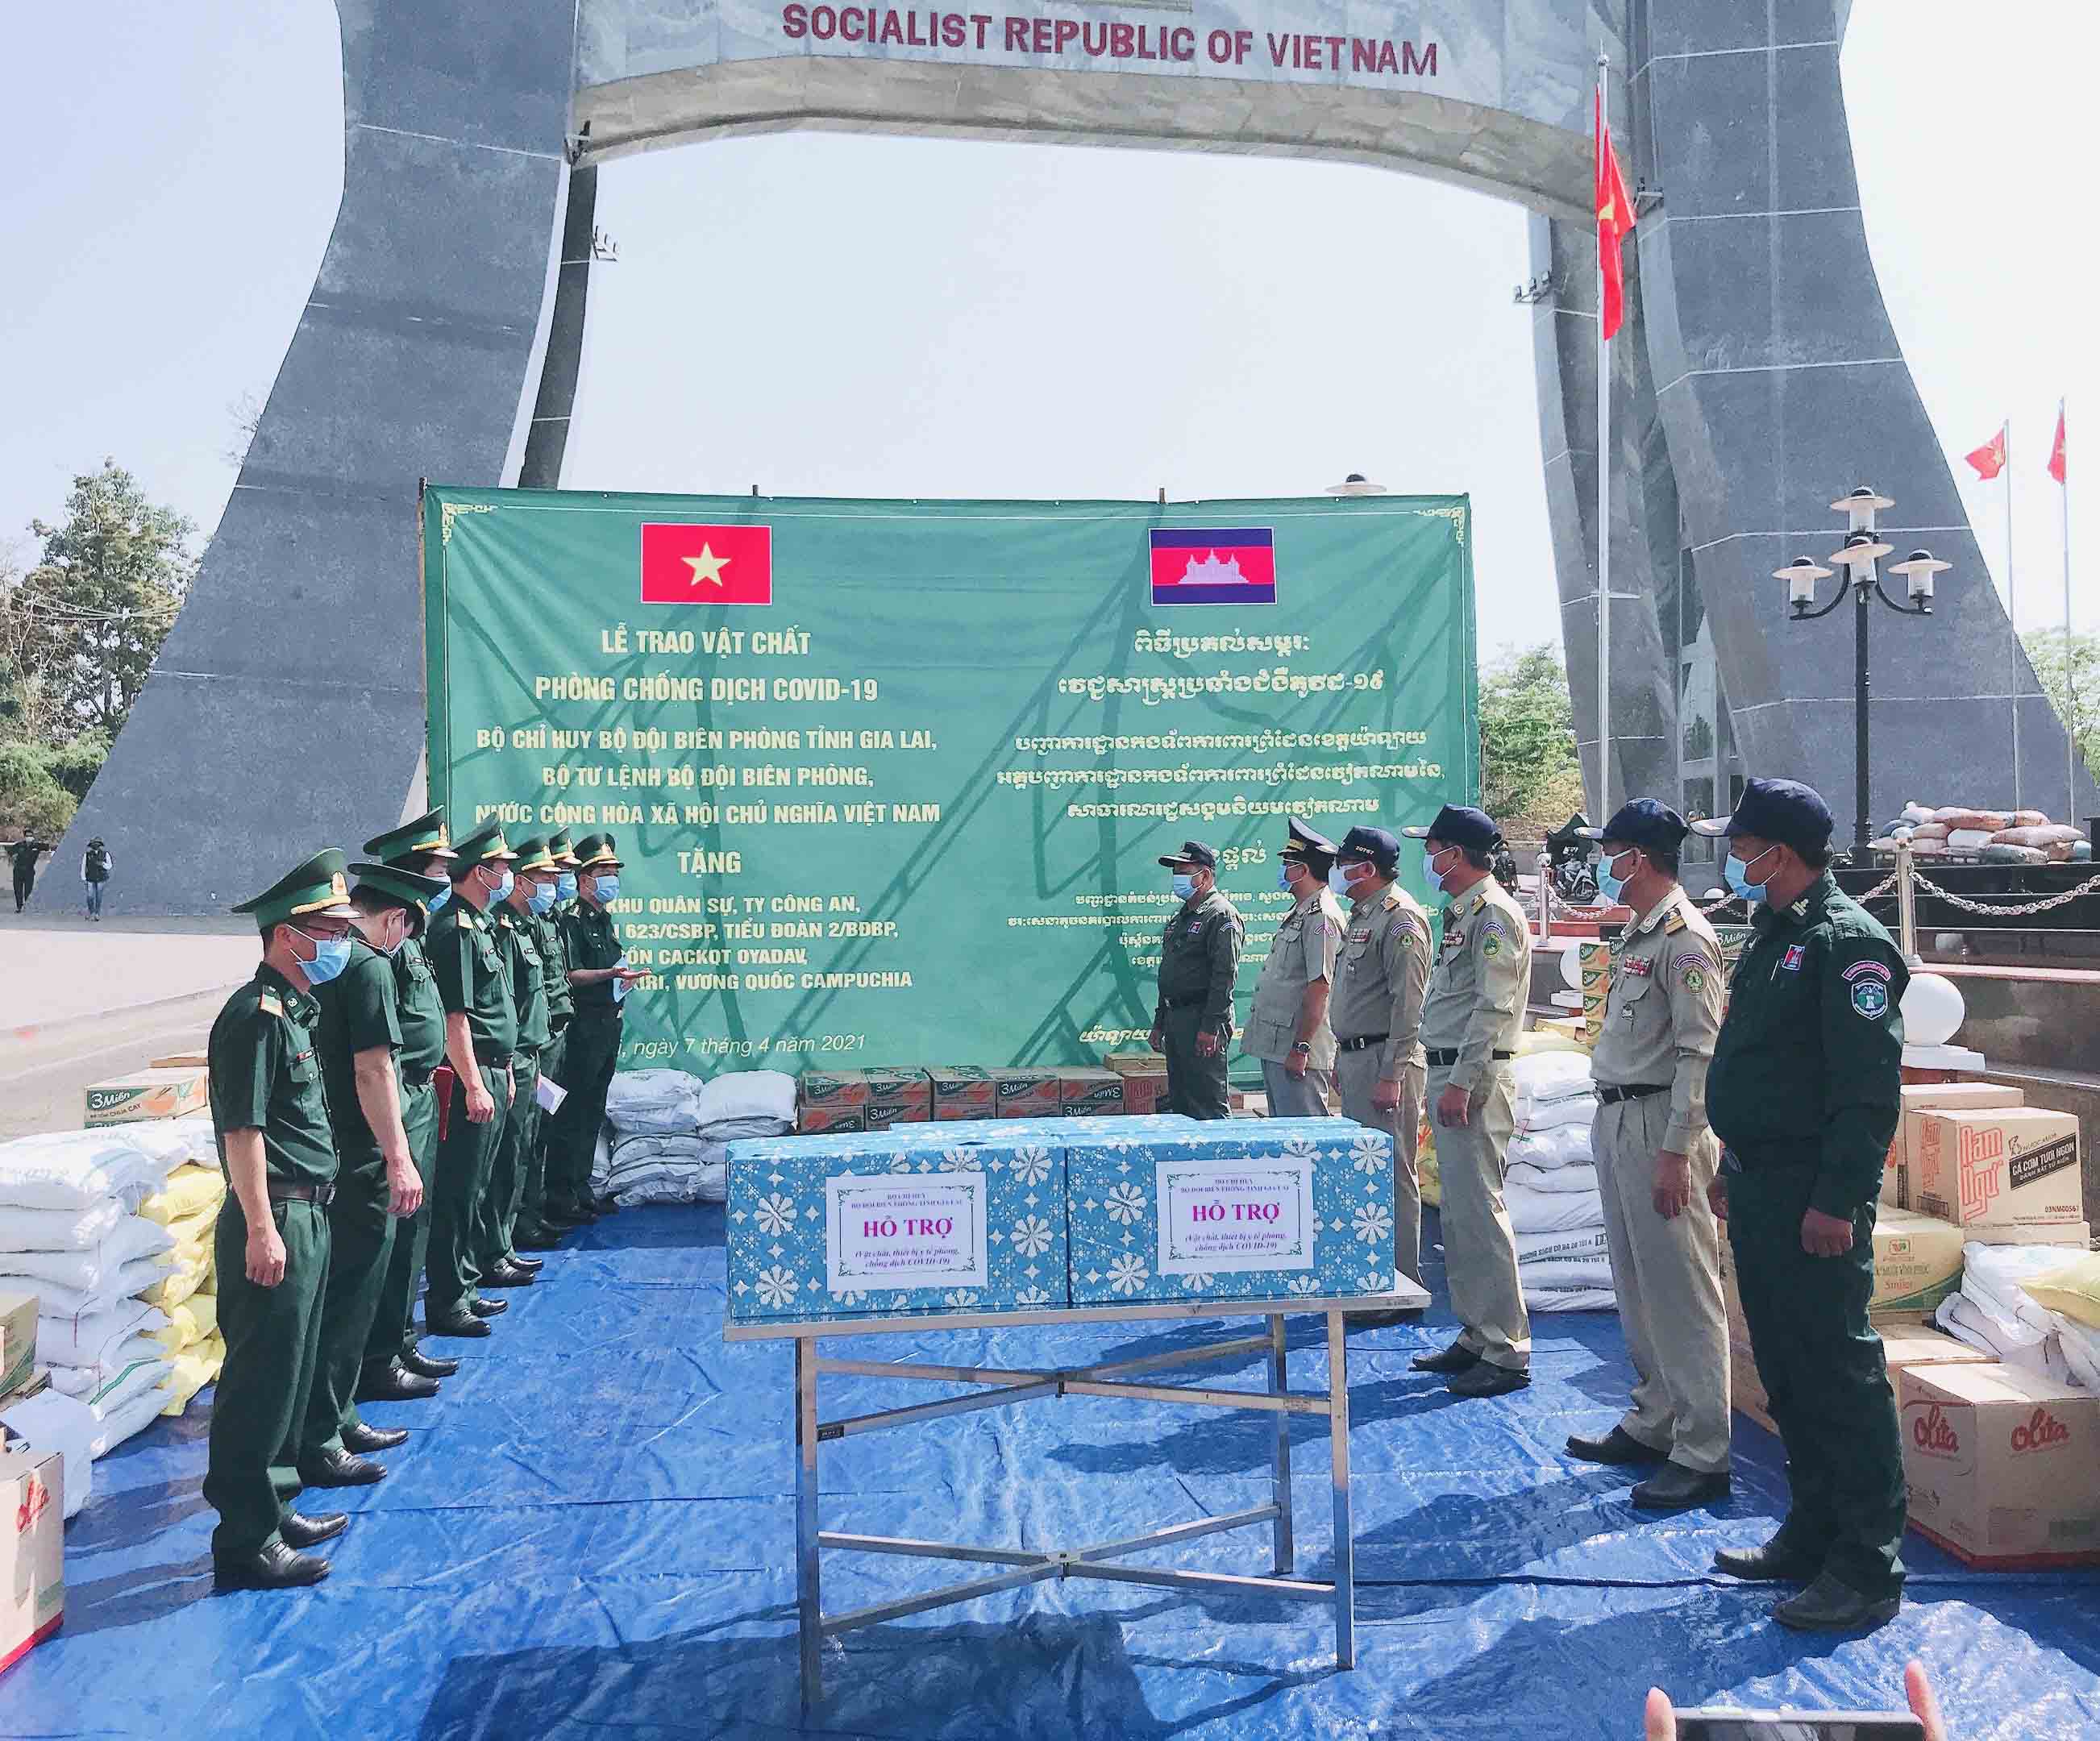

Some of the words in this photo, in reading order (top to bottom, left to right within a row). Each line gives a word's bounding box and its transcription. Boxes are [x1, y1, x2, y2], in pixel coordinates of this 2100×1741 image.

[782, 3, 992, 49] SOCIALIST
[1005, 16, 1196, 61] REPUBLIC
[1208, 29, 1253, 65] OF
[601, 621, 628, 654] LỄ
[636, 630, 694, 654] TRAO
[702, 626, 744, 659] VẬT
[751, 624, 811, 654] CHẤT
[535, 671, 617, 701] PHÒNG
[623, 669, 704, 702] CHỐNG
[711, 677, 766, 706] DỊCH
[773, 677, 879, 703] COVID-19
[476, 725, 506, 753] BỘ
[512, 724, 547, 749] CHỈ
[551, 730, 593, 749] HUY
[599, 726, 627, 754] BỘ
[632, 726, 667, 754] ĐỘI
[674, 727, 722, 749] BIÊN
[729, 726, 800, 750] PHÒNG
[806, 725, 855, 750] TỈNH
[859, 730, 894, 749] GIA
[900, 729, 938, 750] LAI,
[542, 762, 571, 791] BỘ
[576, 766, 604, 787] TƯ
[606, 762, 661, 791] LỆNH
[667, 763, 695, 791] BỘ
[701, 764, 735, 791] ĐỘI
[742, 763, 791, 787] BIÊN
[797, 762, 874, 787] PHÒNG,
[540, 800, 596, 829] CỘNG
[603, 800, 644, 824] HÒA
[650, 802, 679, 825] XÃ
[685, 802, 720, 829] HỘI
[726, 799, 767, 824] CHỦ
[774, 801, 838, 824] NGHĨA
[843, 800, 887, 827] VIỆT
[892, 804, 941, 823] NAM
[677, 847, 742, 879] TẶNG
[649, 894, 701, 916] QUÂN
[743, 897, 765, 913] TY
[771, 892, 823, 913] CÔNG
[726, 916, 764, 938] TIỂU
[770, 919, 822, 937] ĐOÀN
[627, 945, 652, 966] ỒN
[676, 972, 740, 991] VƯƠNG
[745, 969, 795, 991] QUỐC
[801, 970, 913, 990] CAMPUCHIA
[633, 1038, 679, 1058] ngày
[684, 1037, 697, 1054] 7
[701, 1037, 753, 1058] tháng
[759, 1037, 769, 1053] 4
[775, 1036, 814, 1053] năm
[821, 1034, 866, 1052] 2021
[1231, 1202, 1280, 1224] TRỢ
[903, 1216, 954, 1239] TRỢ
